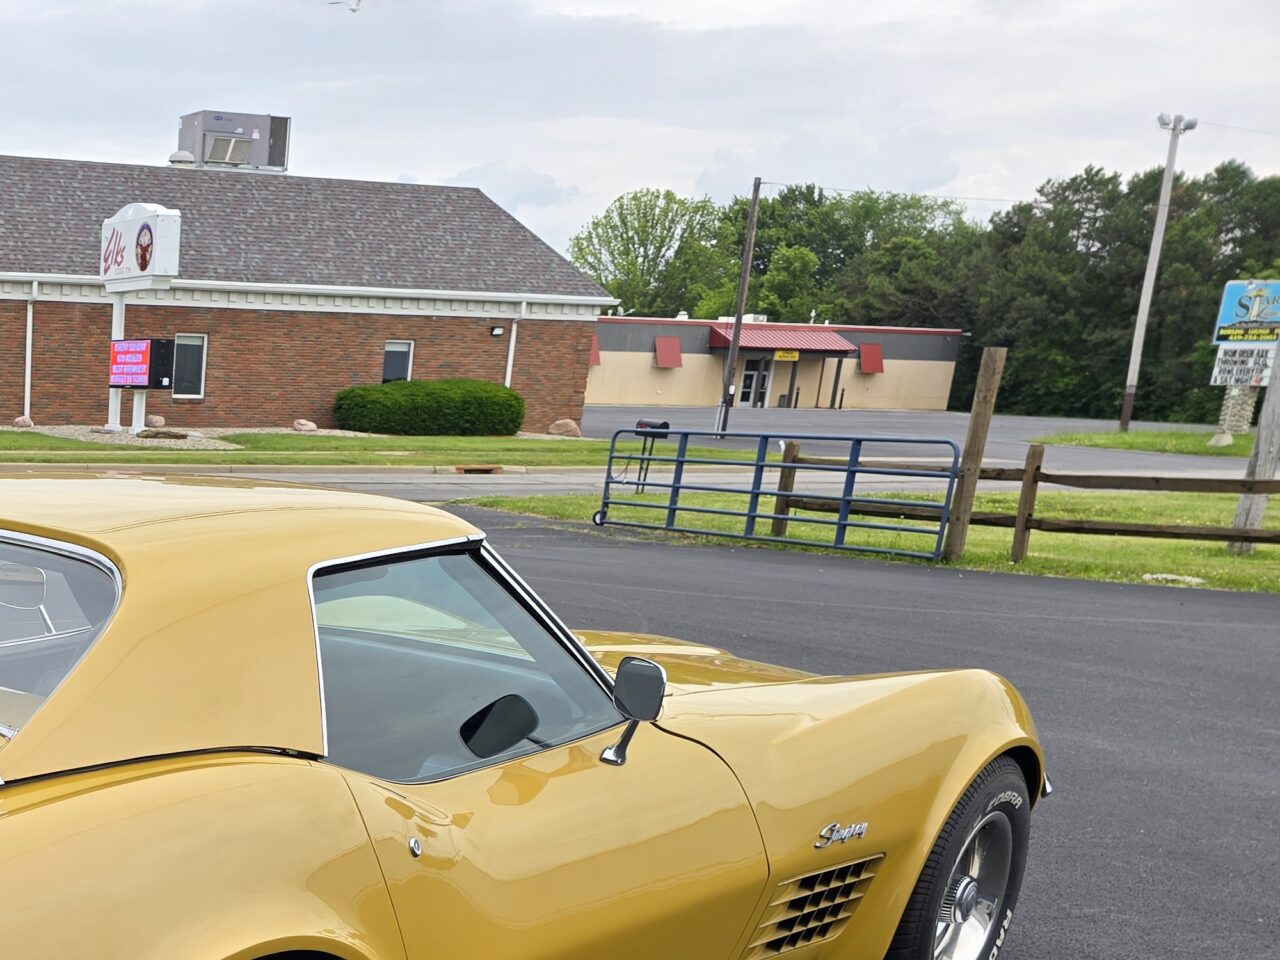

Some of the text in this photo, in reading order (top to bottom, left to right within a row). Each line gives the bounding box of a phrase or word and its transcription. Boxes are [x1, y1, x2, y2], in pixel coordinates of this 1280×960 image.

[104, 227, 126, 275] Elks
[985, 790, 1023, 813] COBRA
[814, 823, 868, 848] Stingray
